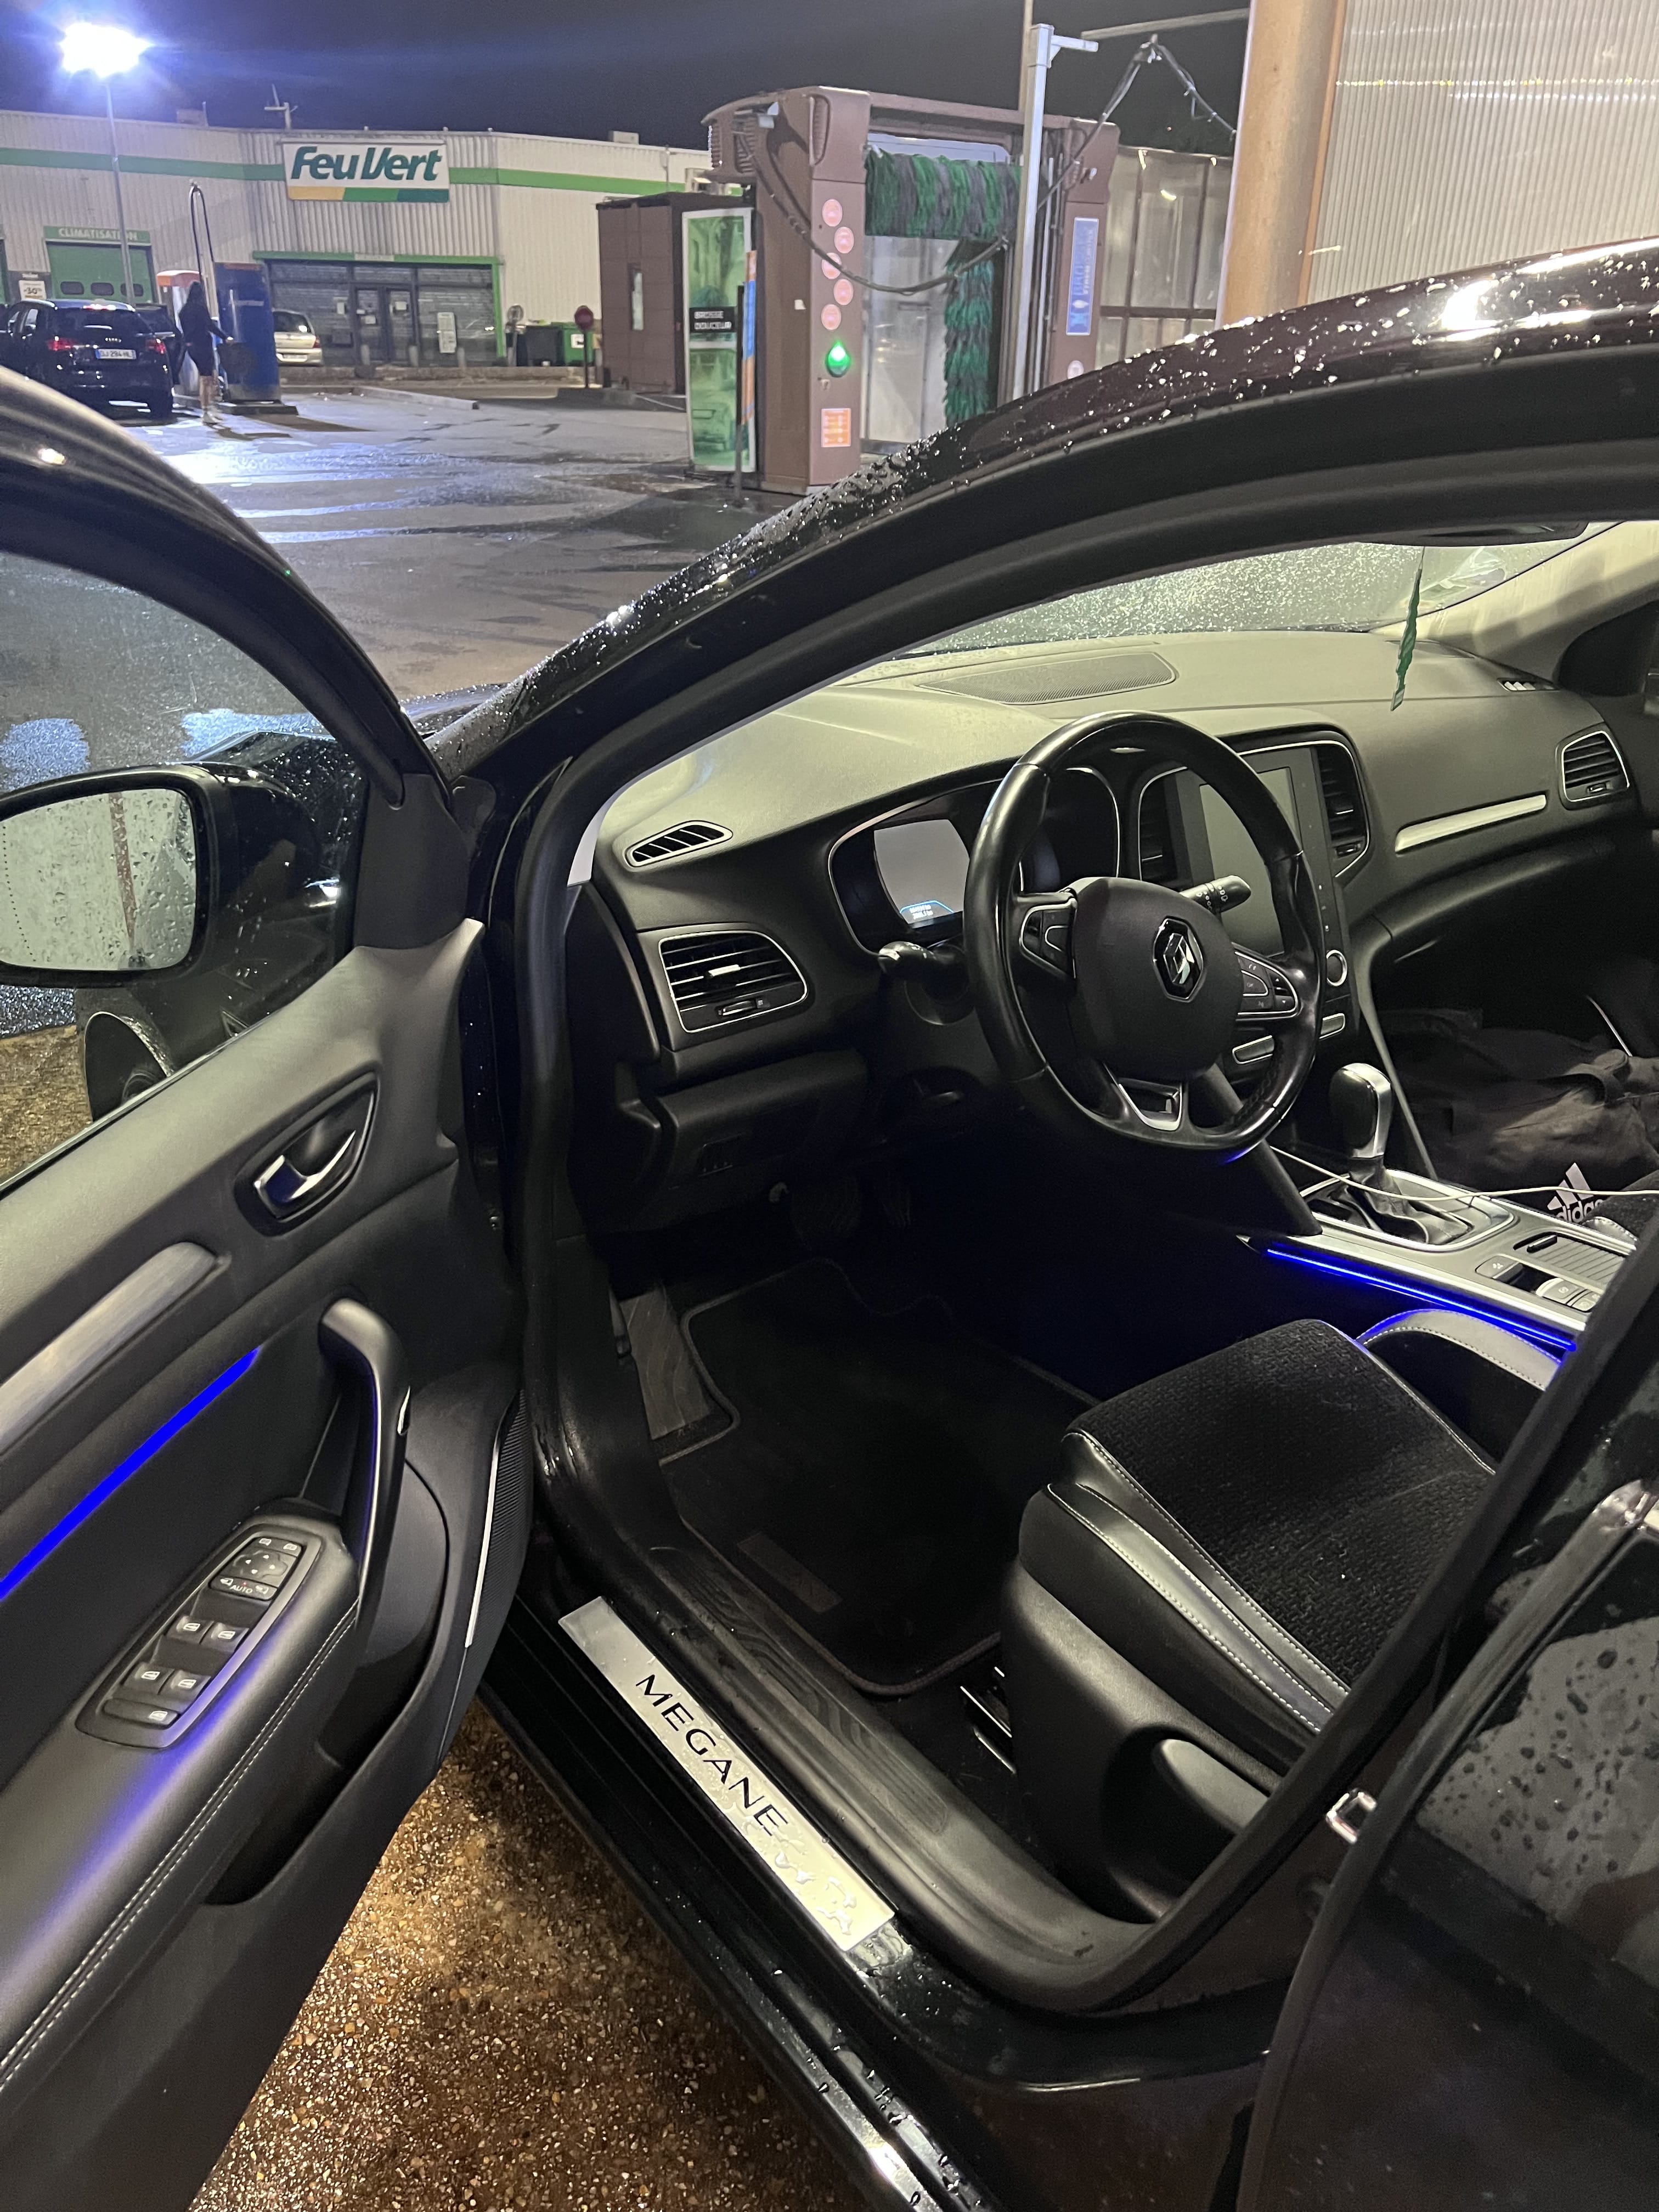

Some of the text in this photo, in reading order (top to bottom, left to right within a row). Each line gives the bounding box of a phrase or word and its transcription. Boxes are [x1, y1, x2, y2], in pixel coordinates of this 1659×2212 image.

[291, 146, 443, 181] Feu Vert
[230, 1585, 253, 1593] AUTO
[635, 1674, 788, 1837] MEGANE
